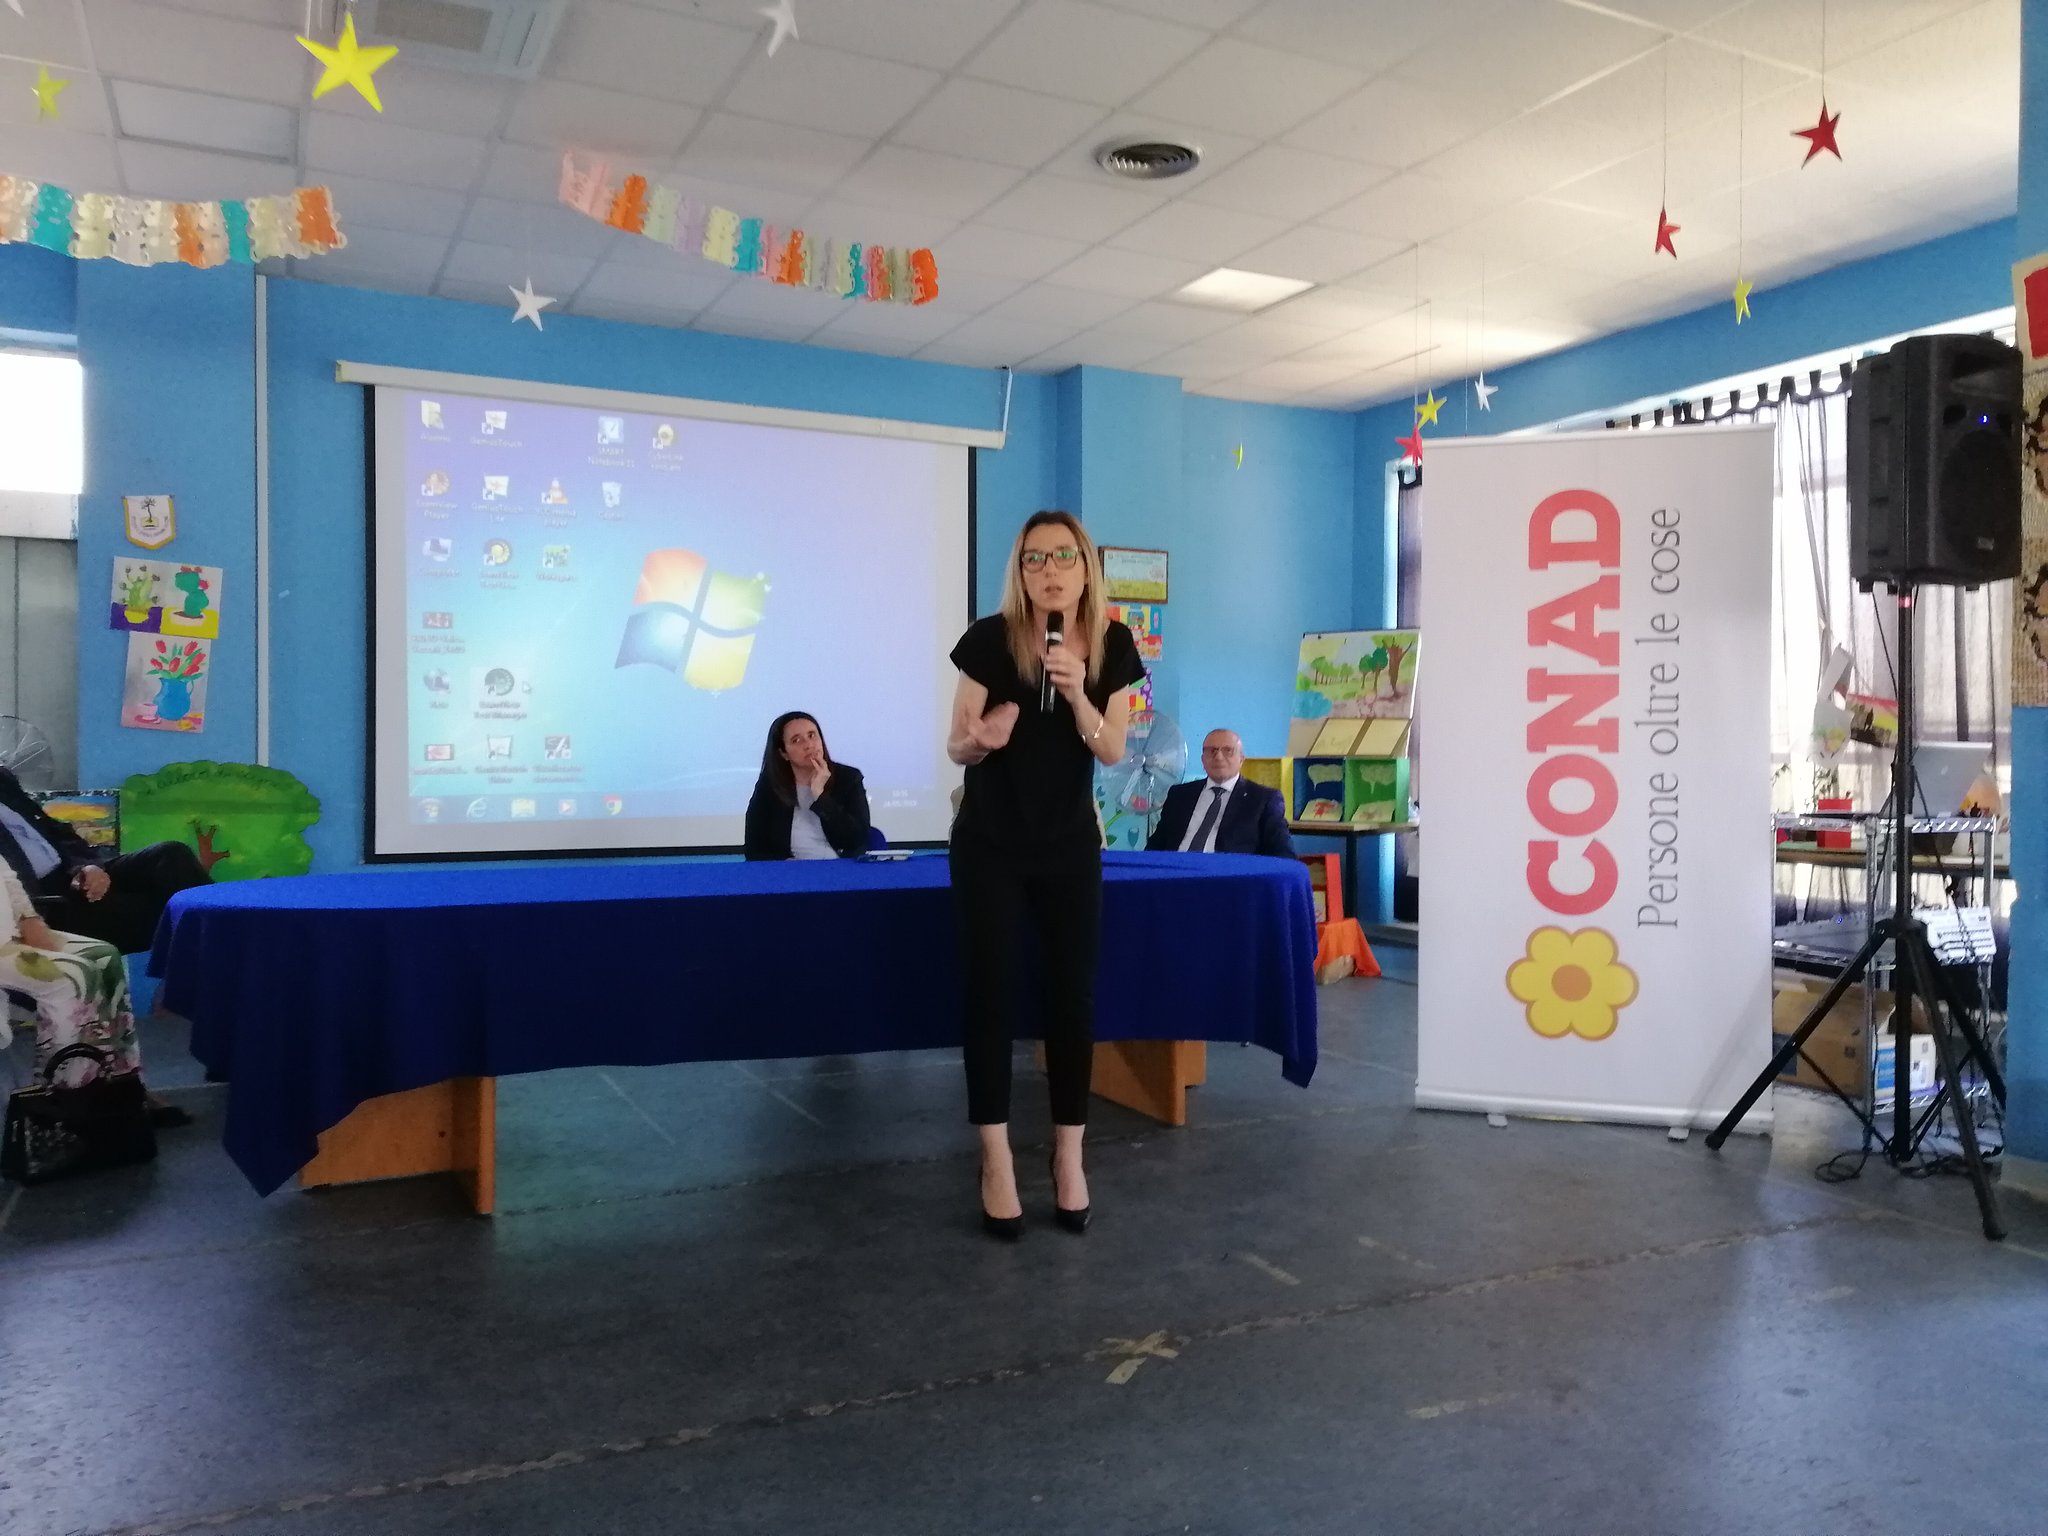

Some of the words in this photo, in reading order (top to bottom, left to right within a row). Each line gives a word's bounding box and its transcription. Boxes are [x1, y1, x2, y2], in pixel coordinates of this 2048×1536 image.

[1649, 506, 1681, 595] cose
[1634, 611, 1680, 645] le
[1526, 489, 1621, 915] CONAD
[1634, 661, 1680, 757] oltre
[1636, 772, 1679, 929] Persone
